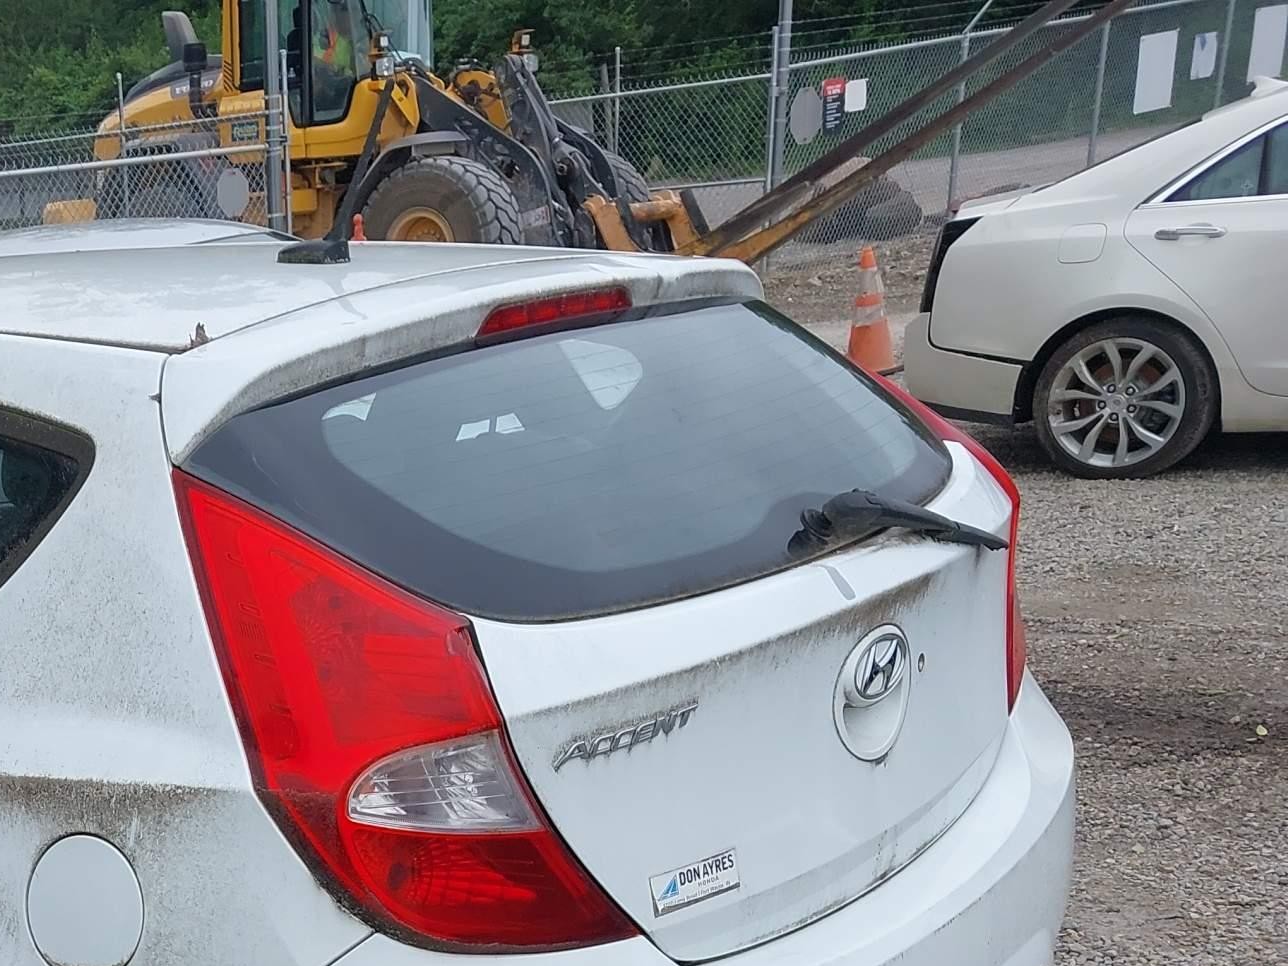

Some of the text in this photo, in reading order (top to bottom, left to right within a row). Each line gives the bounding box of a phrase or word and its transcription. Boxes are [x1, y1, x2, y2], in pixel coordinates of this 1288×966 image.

[553, 702, 699, 773] ACCENT
[678, 853, 734, 886] DON AYRES
